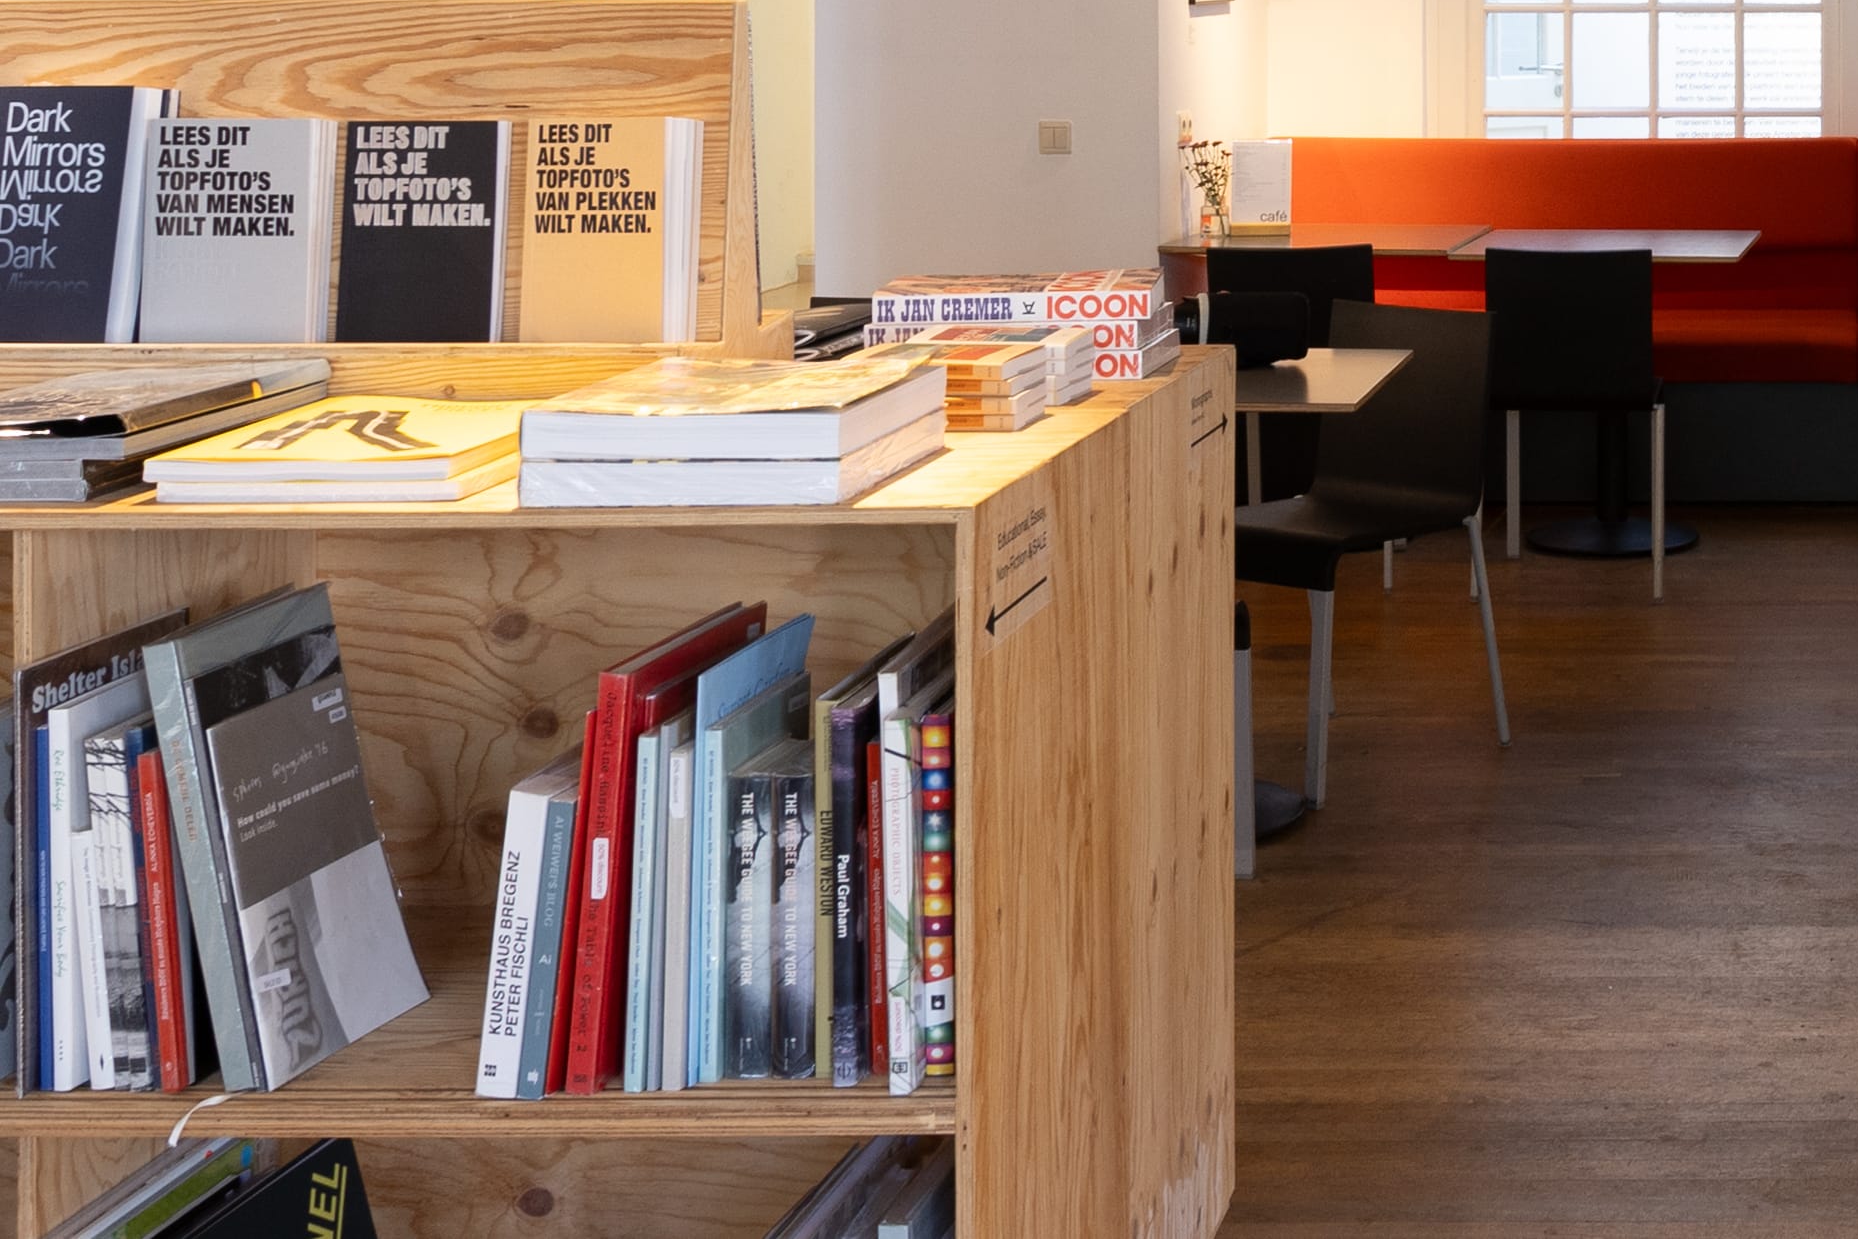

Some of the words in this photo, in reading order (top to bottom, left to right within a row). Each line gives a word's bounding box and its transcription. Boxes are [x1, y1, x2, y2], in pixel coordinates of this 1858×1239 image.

[6, 101, 73, 133] Dark
[160, 126, 210, 146] LEES
[217, 126, 251, 146] DIT
[356, 126, 410, 149] LEES
[413, 126, 449, 149] DIT
[538, 124, 579, 143] LEES
[584, 124, 612, 143] DIT
[2, 135, 106, 167] Mirrors
[158, 149, 200, 168] ALS
[205, 149, 230, 168] JE
[354, 152, 397, 175] ALS
[401, 152, 428, 175] JE
[537, 147, 570, 166] ALS
[574, 146, 595, 165] JE
[157, 171, 271, 191] TOPFOTO'S
[354, 177, 472, 201] TOPFOTO'S
[536, 169, 630, 188] TOPFOTO'S
[156, 194, 199, 214] VAN
[207, 194, 294, 214] MENSEN
[536, 192, 569, 211] VAN
[576, 191, 656, 211] PLEKKEN
[155, 217, 206, 236] WILT
[212, 217, 295, 237] MAKEN.
[353, 203, 407, 227] WILT
[412, 203, 491, 227] MAKEN.
[535, 214, 575, 234] WILT
[581, 214, 651, 234] MAKEN.
[1260, 210, 1287, 222] café
[877, 299, 895, 322] IK
[901, 298, 935, 323] JAN
[941, 297, 1013, 321] CREMER
[1047, 294, 1148, 319] ICOON
[32, 667, 106, 713] Shelter
[237, 815, 254, 829] How
[255, 802, 276, 819] could
[277, 799, 292, 812] you
[741, 792, 753, 814] THE
[784, 792, 796, 814] THE
[891, 768, 900, 846] PHOTOGRAPHIC
[554, 815, 565, 827] AI
[740, 817, 753, 864] WEEGEE
[784, 817, 796, 864] WEEGEE
[819, 810, 832, 861] EDWARD
[837, 854, 849, 881] Paul
[892, 852, 900, 895] OBJECTS
[740, 867, 752, 902] GUIDE
[783, 867, 796, 902] GUIDE
[543, 891, 556, 926] BLOG
[740, 906, 752, 920] TO
[783, 906, 795, 920] TO
[836, 884, 849, 937] Graham
[486, 934, 512, 1035] KUNSTHAUS
[499, 851, 523, 930] BREGENZ
[510, 916, 529, 978] FISCHLI
[739, 924, 751, 951] NEW
[783, 924, 795, 951] NEW
[739, 955, 751, 985] YORK
[783, 955, 795, 985] YORK
[503, 984, 521, 1037] PETER
